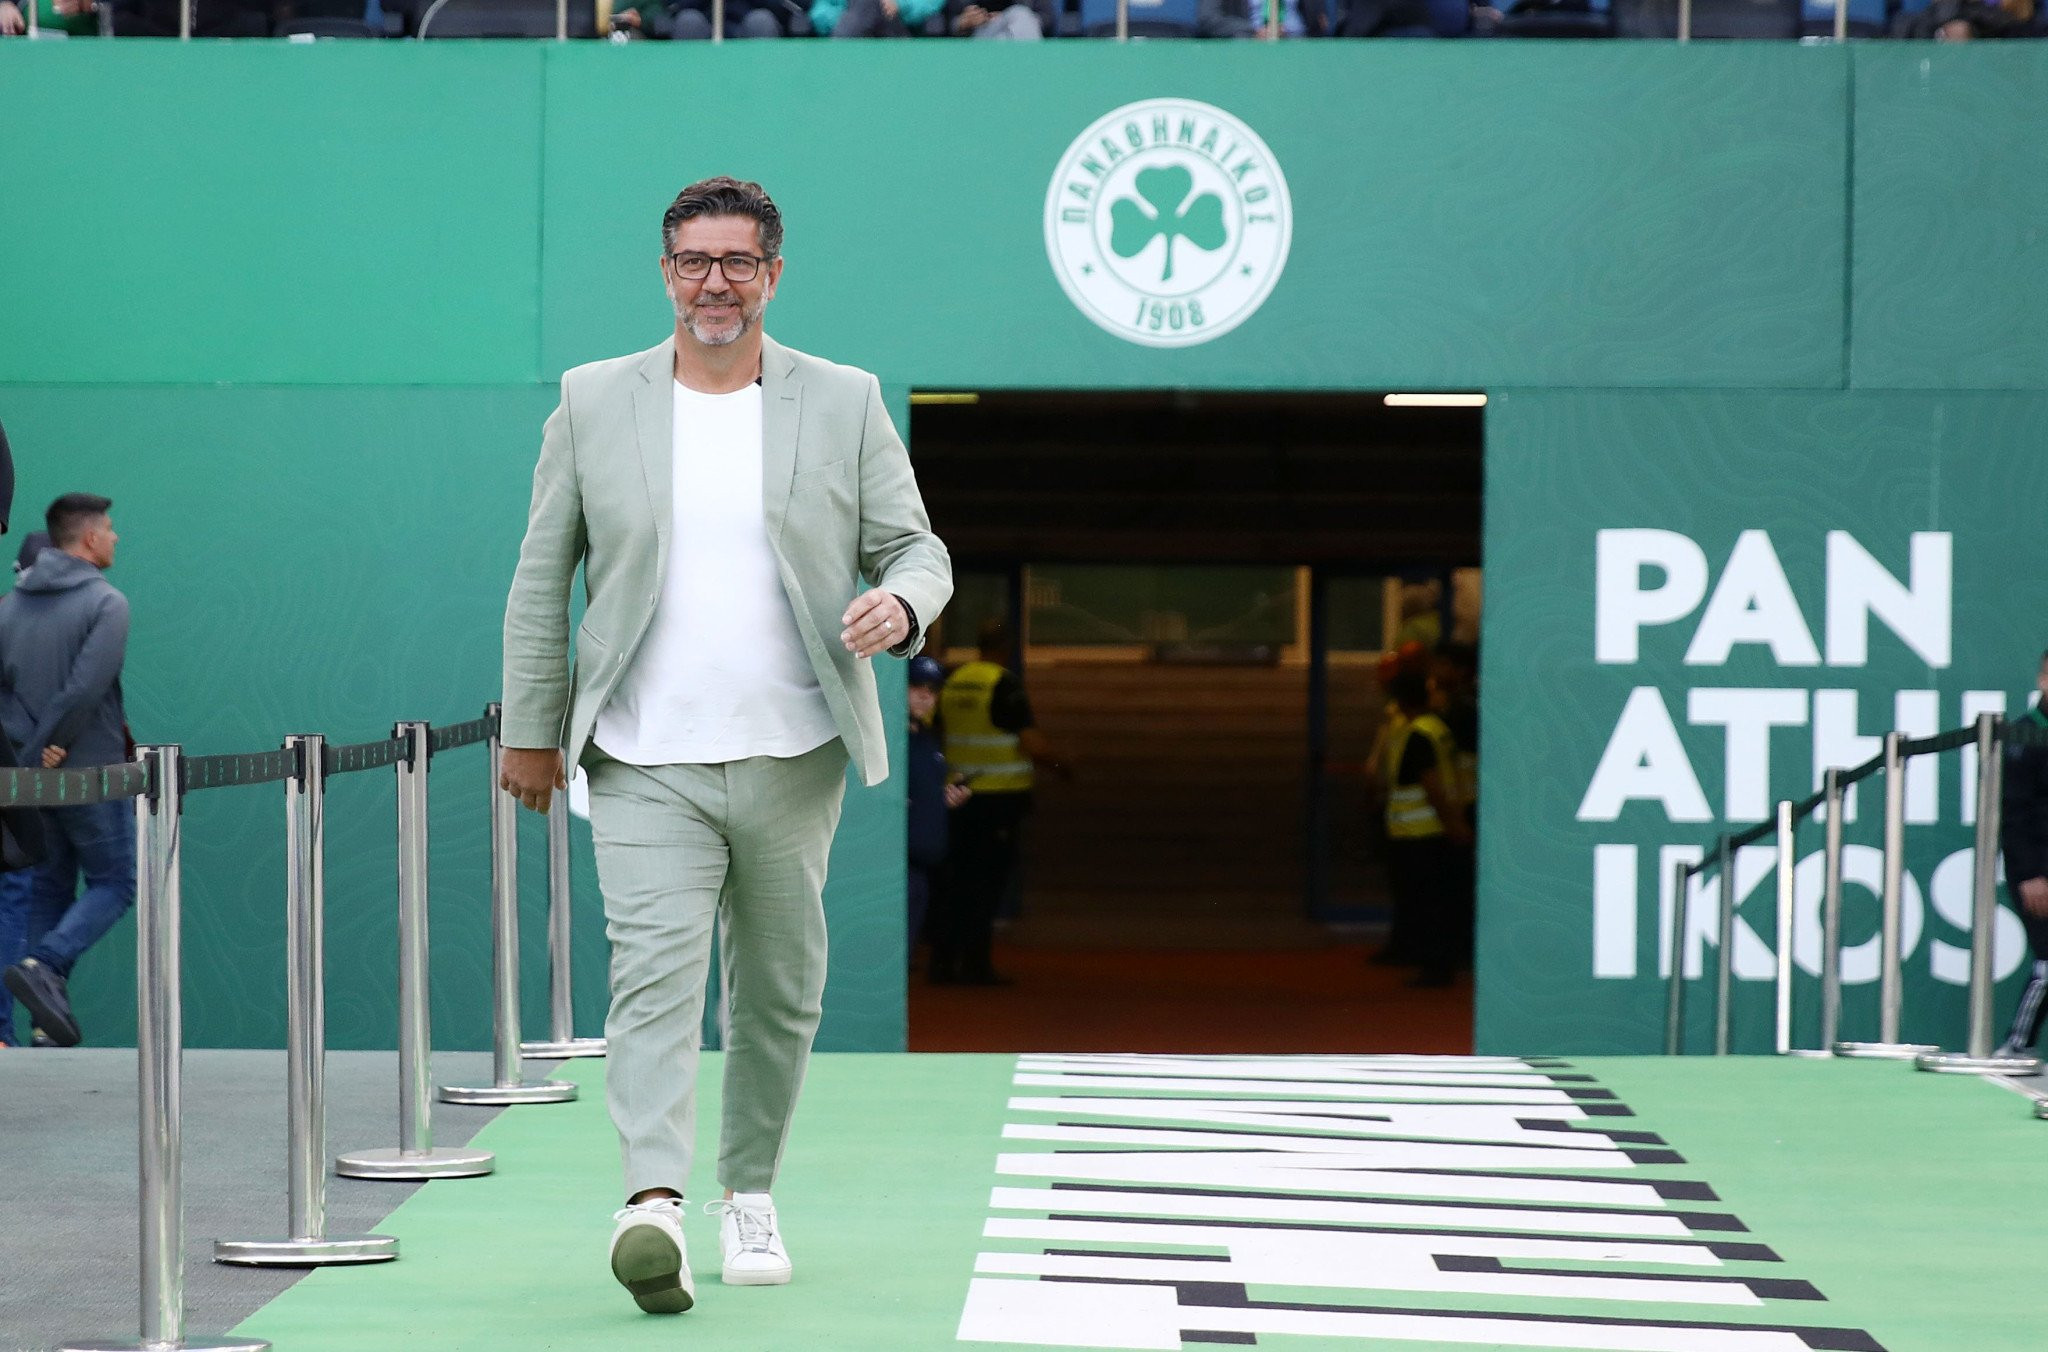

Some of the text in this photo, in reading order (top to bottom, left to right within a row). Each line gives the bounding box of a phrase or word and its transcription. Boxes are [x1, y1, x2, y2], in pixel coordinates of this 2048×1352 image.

[1135, 299, 1205, 331] 1908
[1595, 528, 1953, 668] PAN
[1592, 843, 2028, 986] IKOS
